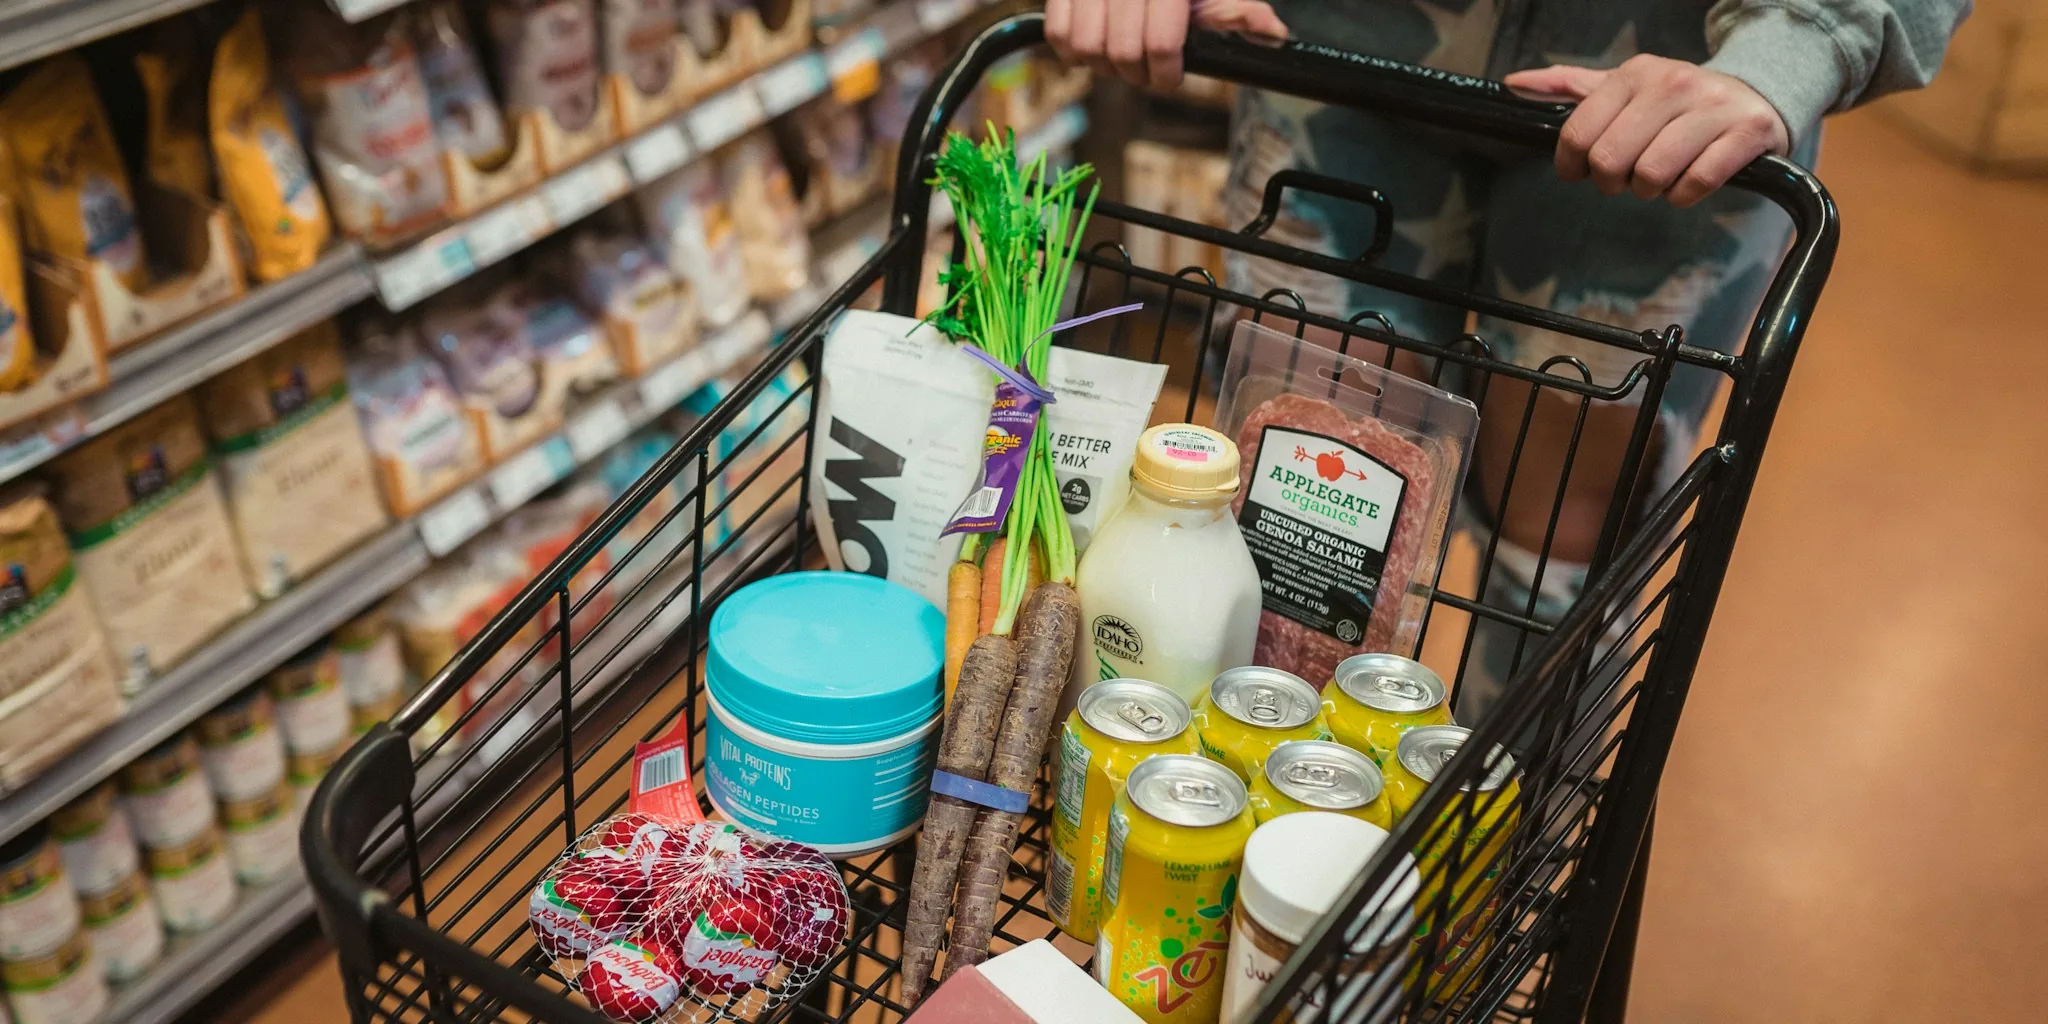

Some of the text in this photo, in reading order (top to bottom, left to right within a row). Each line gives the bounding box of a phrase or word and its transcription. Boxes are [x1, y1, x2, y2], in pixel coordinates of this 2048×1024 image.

[986, 434, 1022, 446] rganic
[1058, 434, 1112, 454] BETTER
[1061, 452, 1090, 469] MIX
[825, 416, 906, 580] OW
[1072, 483, 1082, 494] 2g
[1269, 465, 1380, 519] APPLEGATE
[1281, 488, 1358, 527] organics
[1255, 519, 1364, 571] GENOA SALAMI
[1261, 509, 1367, 558] UNCURED ORGANIC
[1288, 553, 1299, 561] and
[1299, 557, 1321, 570] cultured
[1292, 548, 1310, 559] added
[1327, 561, 1336, 569] for
[1336, 565, 1352, 575] those
[1352, 572, 1377, 586] naturally
[1272, 563, 1291, 576] GLUTEN
[1296, 573, 1316, 585] CASEIN
[1316, 581, 1329, 591] FREE
[1272, 573, 1324, 599] KEEP REFRIGERATED
[1307, 571, 1337, 586] HUMANELY
[1261, 579, 1274, 591] NET
[1288, 591, 1294, 600] 4
[1307, 600, 1329, 615] (113g)
[1097, 625, 1139, 652] IDAHO
[720, 735, 742, 763] VITAL
[744, 753, 792, 790] PROTEINS
[708, 755, 752, 802] COLLAGEN
[755, 795, 820, 819] PEPTIDES
[1164, 860, 1206, 872] LEMON
[1164, 870, 1199, 882] TWIST
[597, 949, 668, 991] Babybel
